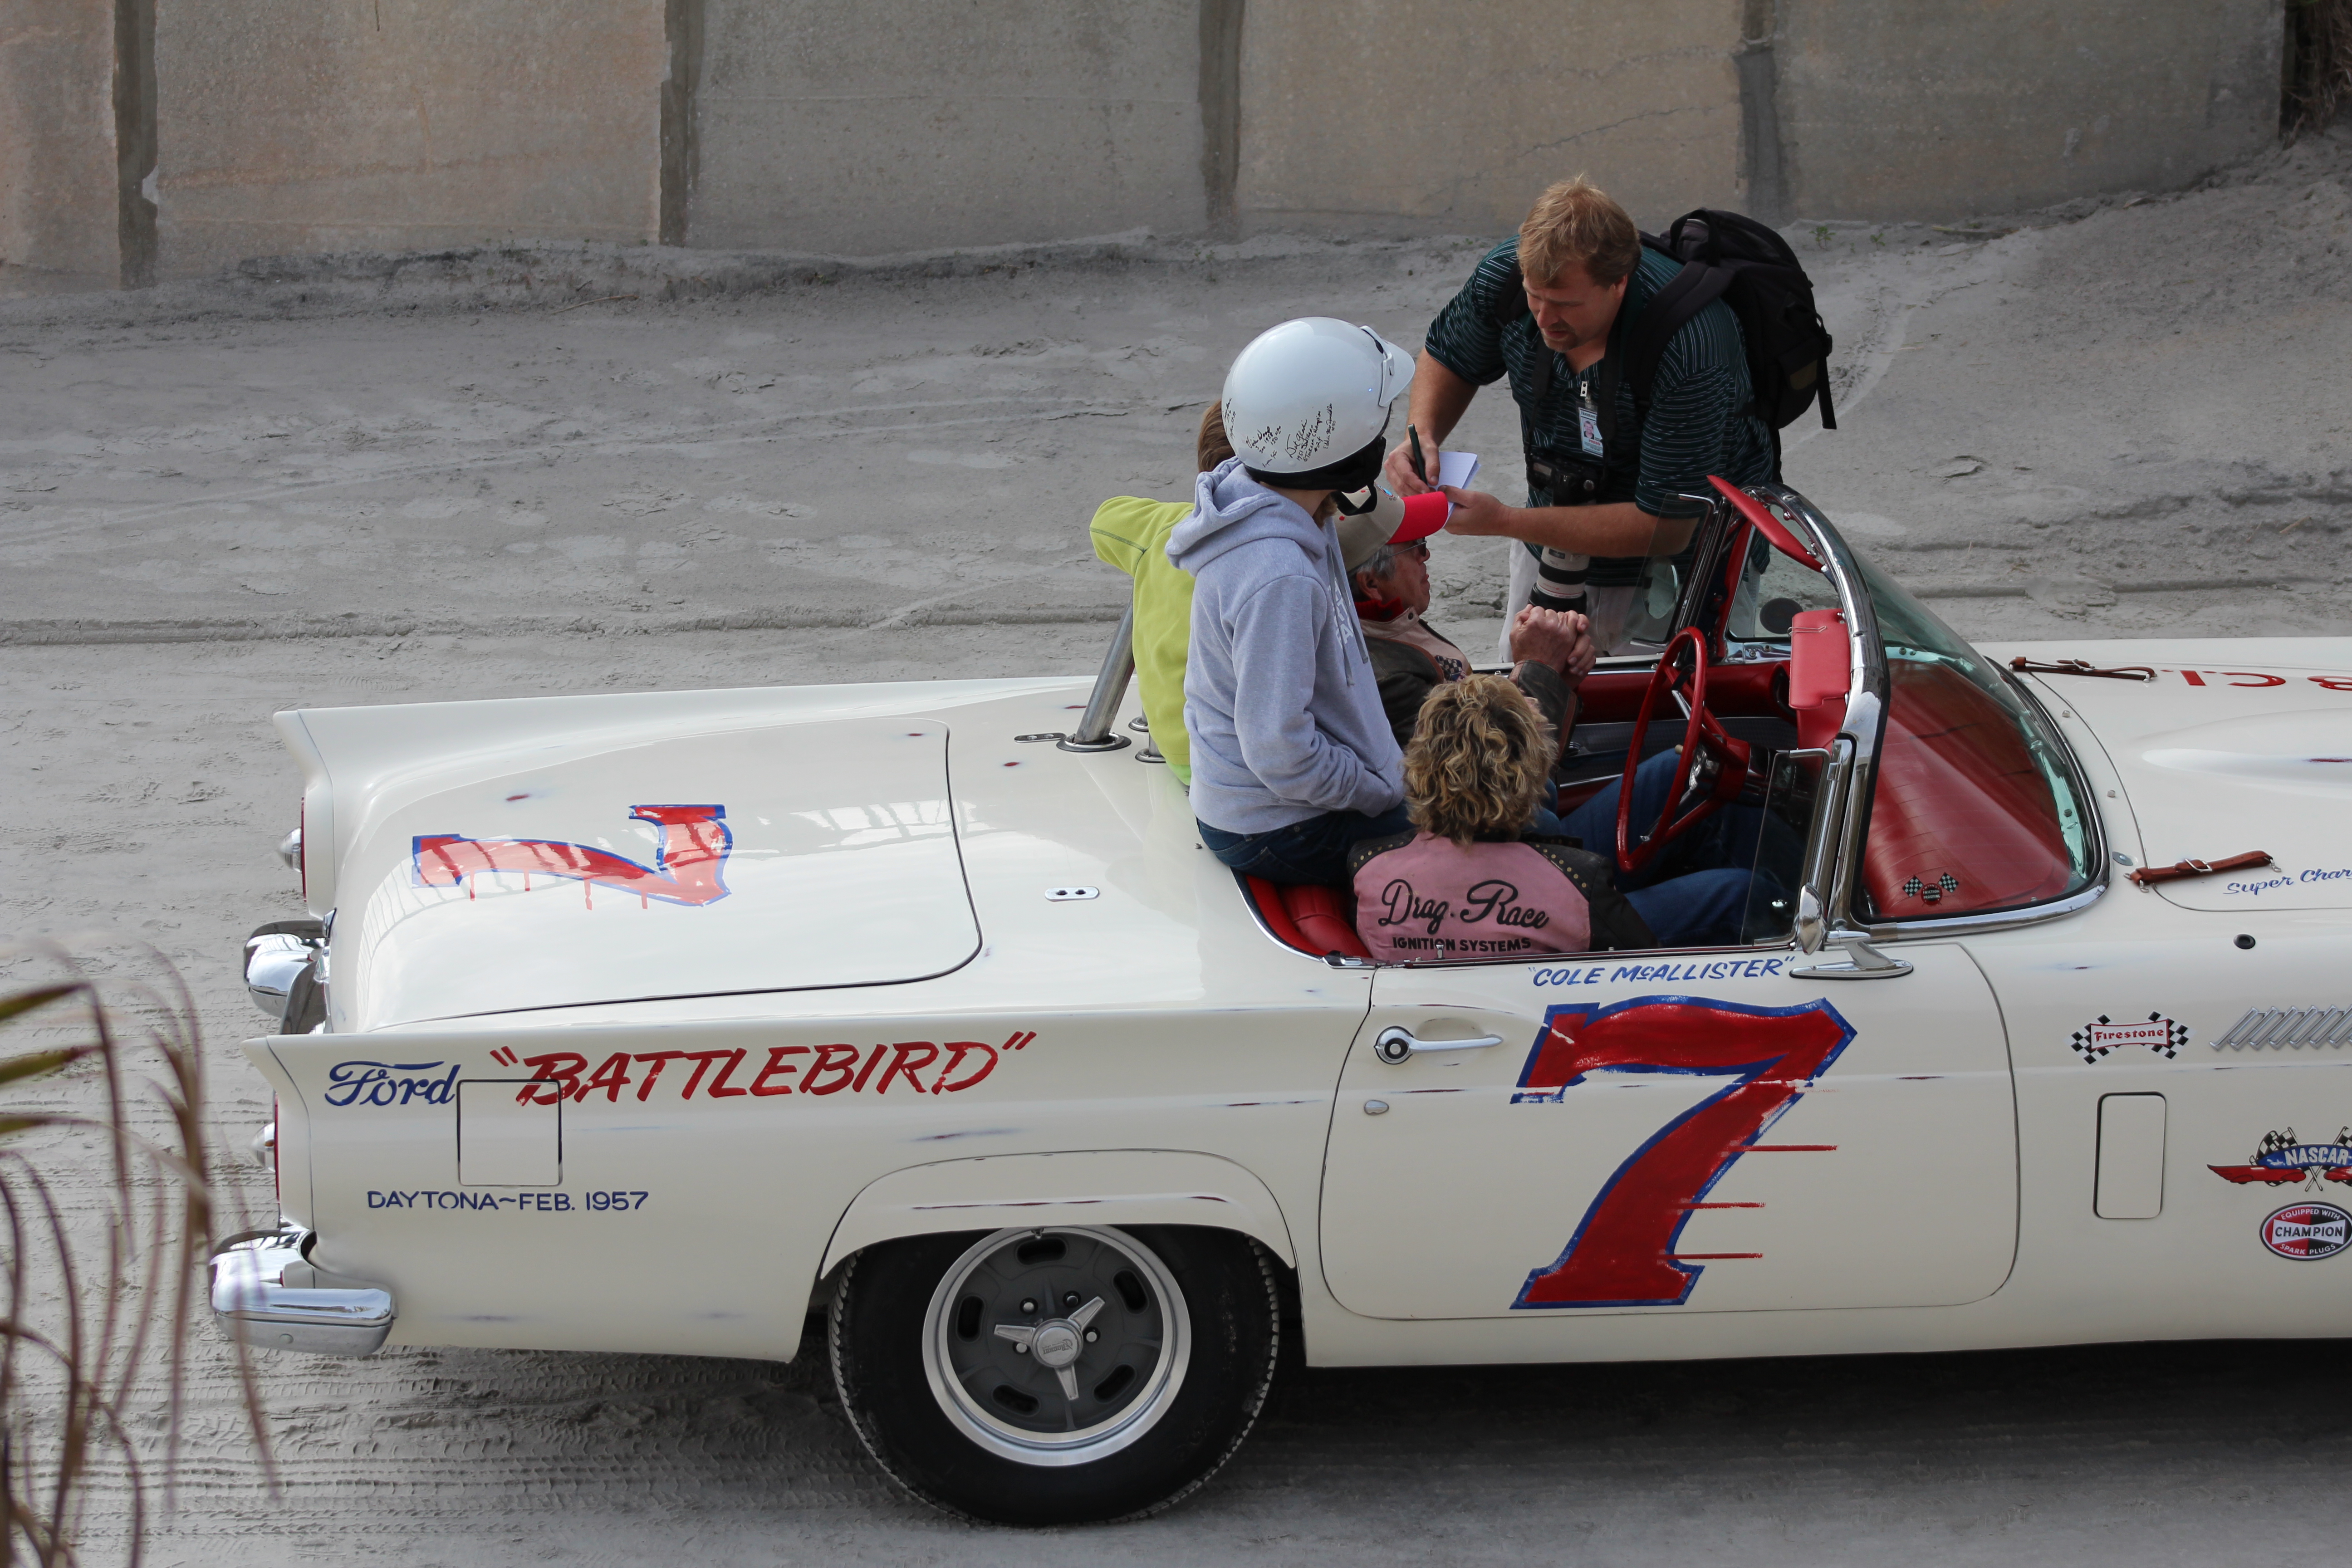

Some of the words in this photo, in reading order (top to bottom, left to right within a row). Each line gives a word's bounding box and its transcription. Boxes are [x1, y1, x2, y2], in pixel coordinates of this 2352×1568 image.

[2222, 876, 2294, 896] Super
[2299, 868, 2352, 882] Char
[1392, 936, 1456, 951] IGNITION
[1459, 937, 1531, 952] SYSTEMS
[2093, 1028, 2164, 1042] Firestone
[324, 1060, 461, 1107] Ford
[1509, 994, 1858, 1310] 7
[2284, 1146, 2349, 1166] NASCAR
[586, 1191, 650, 1211] 1957
[2281, 1208, 2319, 1220] EQUIPPED
[2321, 1209, 2341, 1220] WITH
[2274, 1226, 2343, 1237] CHAMPION
[2279, 1243, 2306, 1255] SPARK
[2309, 1243, 2336, 1255] PLUGS
